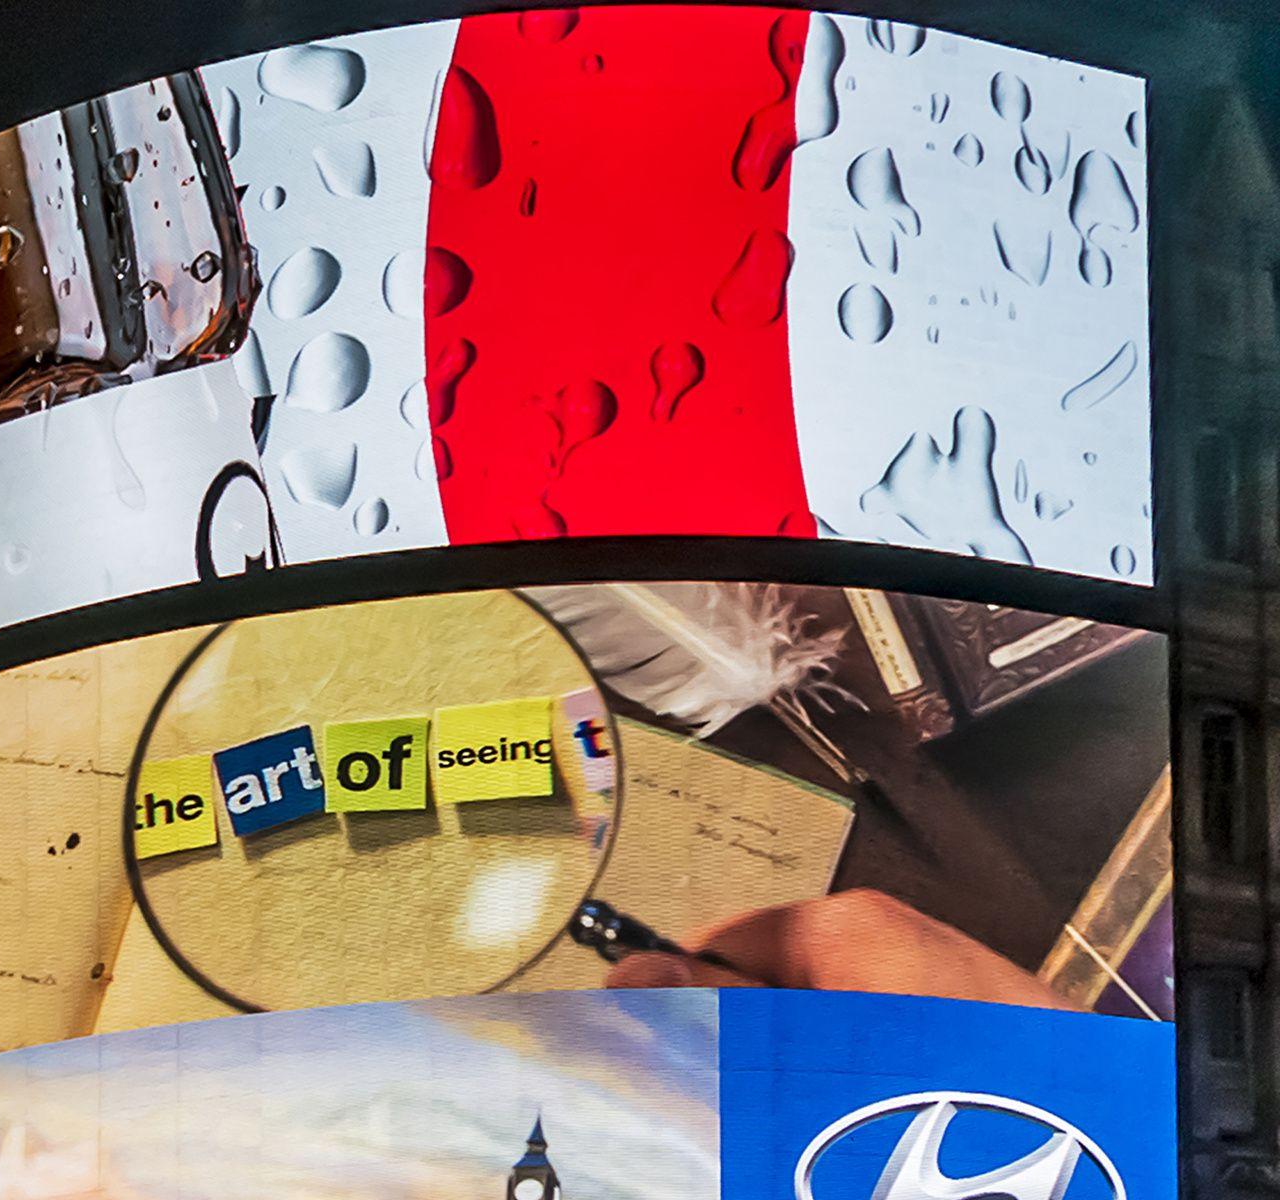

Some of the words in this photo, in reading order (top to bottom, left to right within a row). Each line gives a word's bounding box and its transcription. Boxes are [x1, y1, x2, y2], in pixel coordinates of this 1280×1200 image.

[135, 787, 203, 832] the
[225, 744, 323, 815] art
[337, 734, 413, 792] of
[437, 736, 553, 771] seeing
